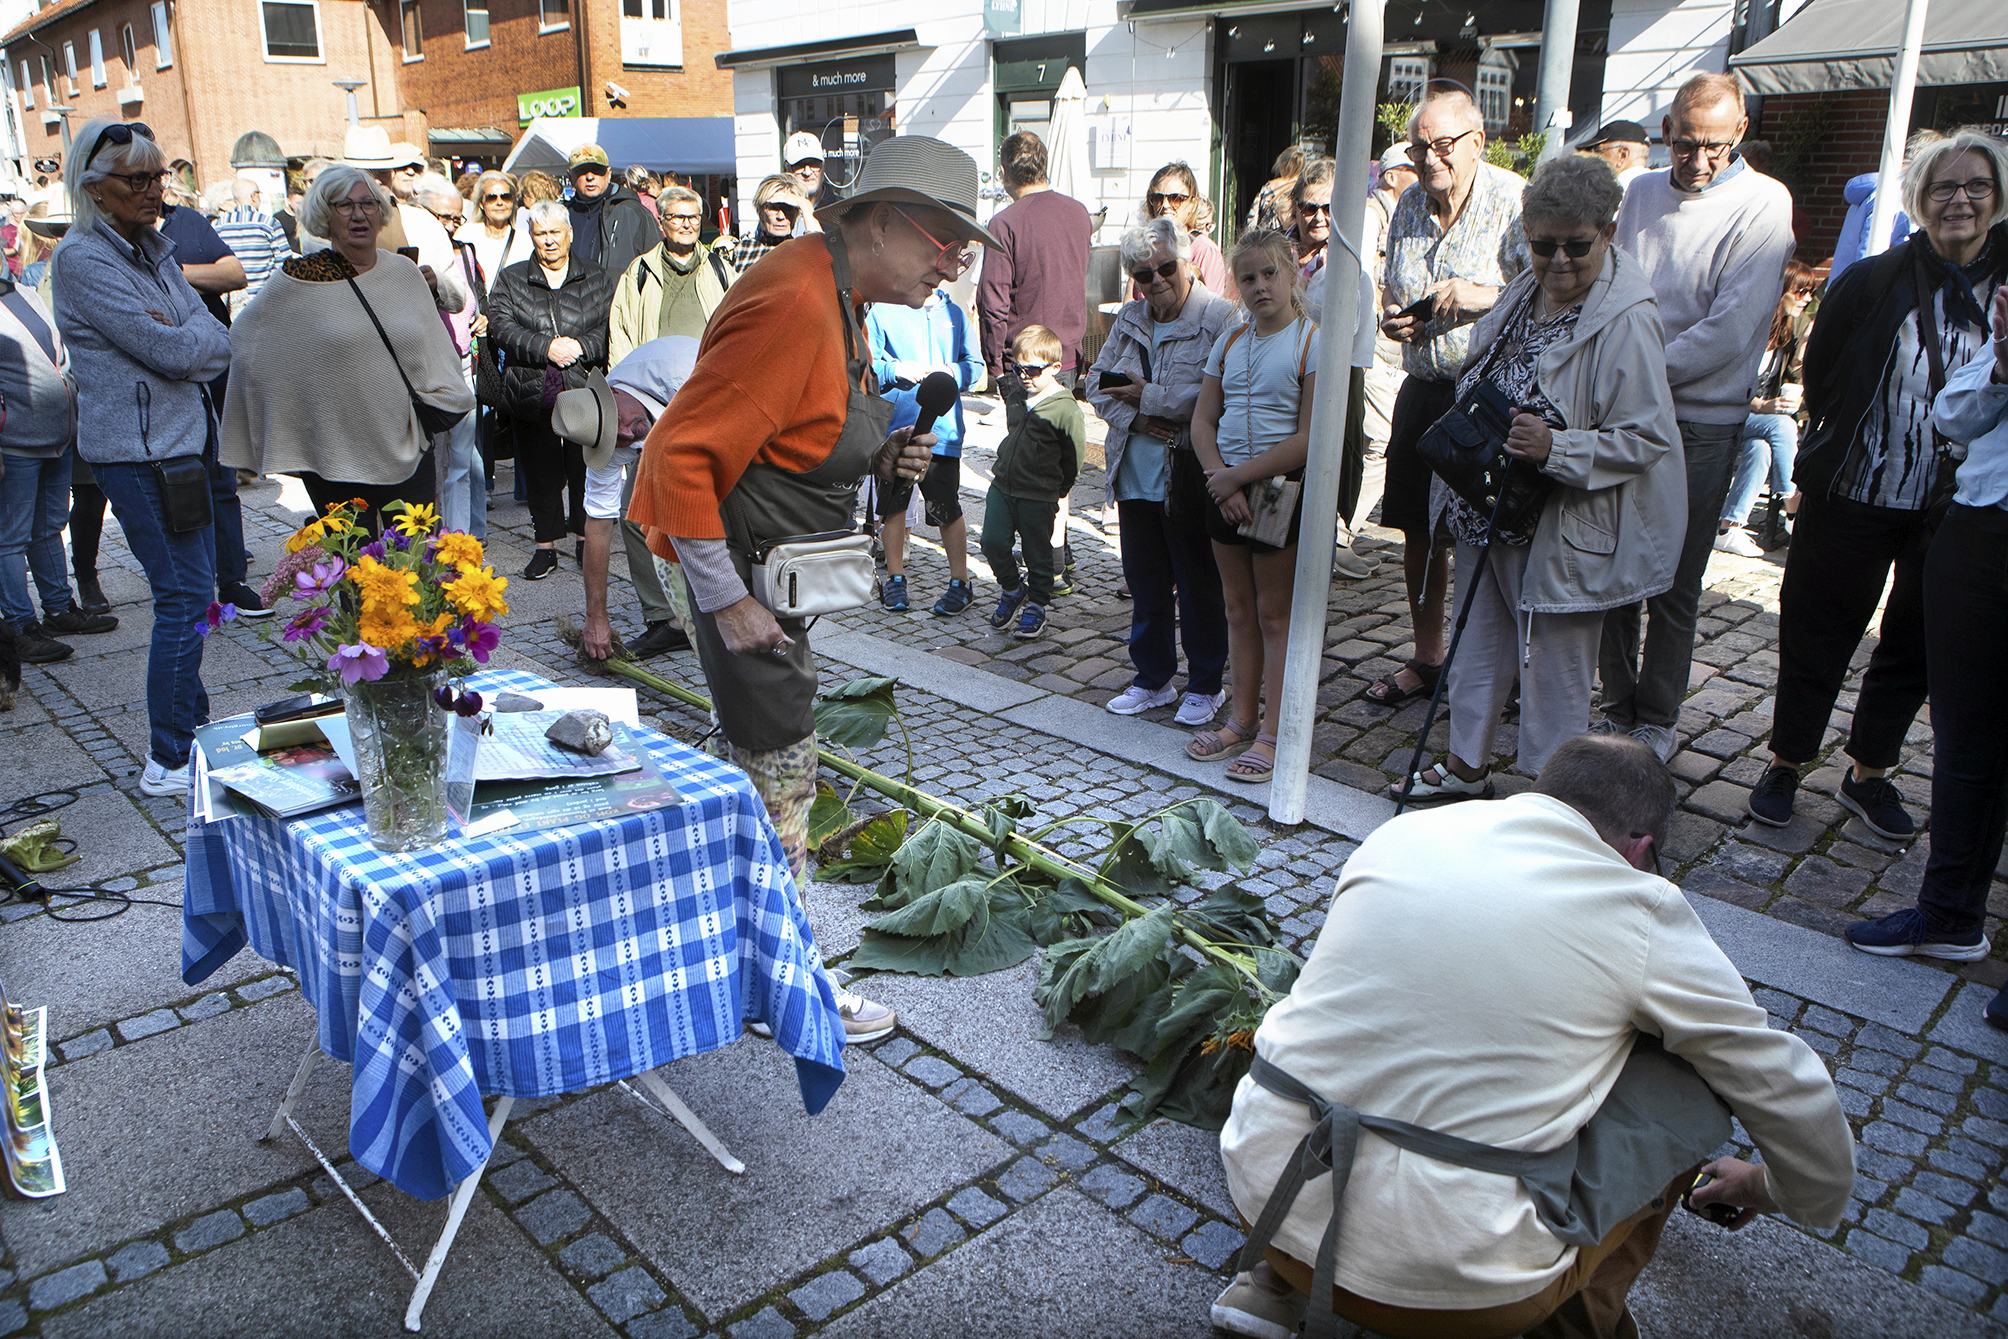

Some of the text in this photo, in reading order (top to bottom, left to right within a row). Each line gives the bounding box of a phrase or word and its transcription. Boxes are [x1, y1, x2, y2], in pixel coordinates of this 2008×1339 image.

[812, 70, 866, 87] & much more
[1037, 64, 1046, 82] 7
[518, 96, 576, 120] LOOP
[828, 148, 844, 158] much
[844, 149, 860, 158] more
